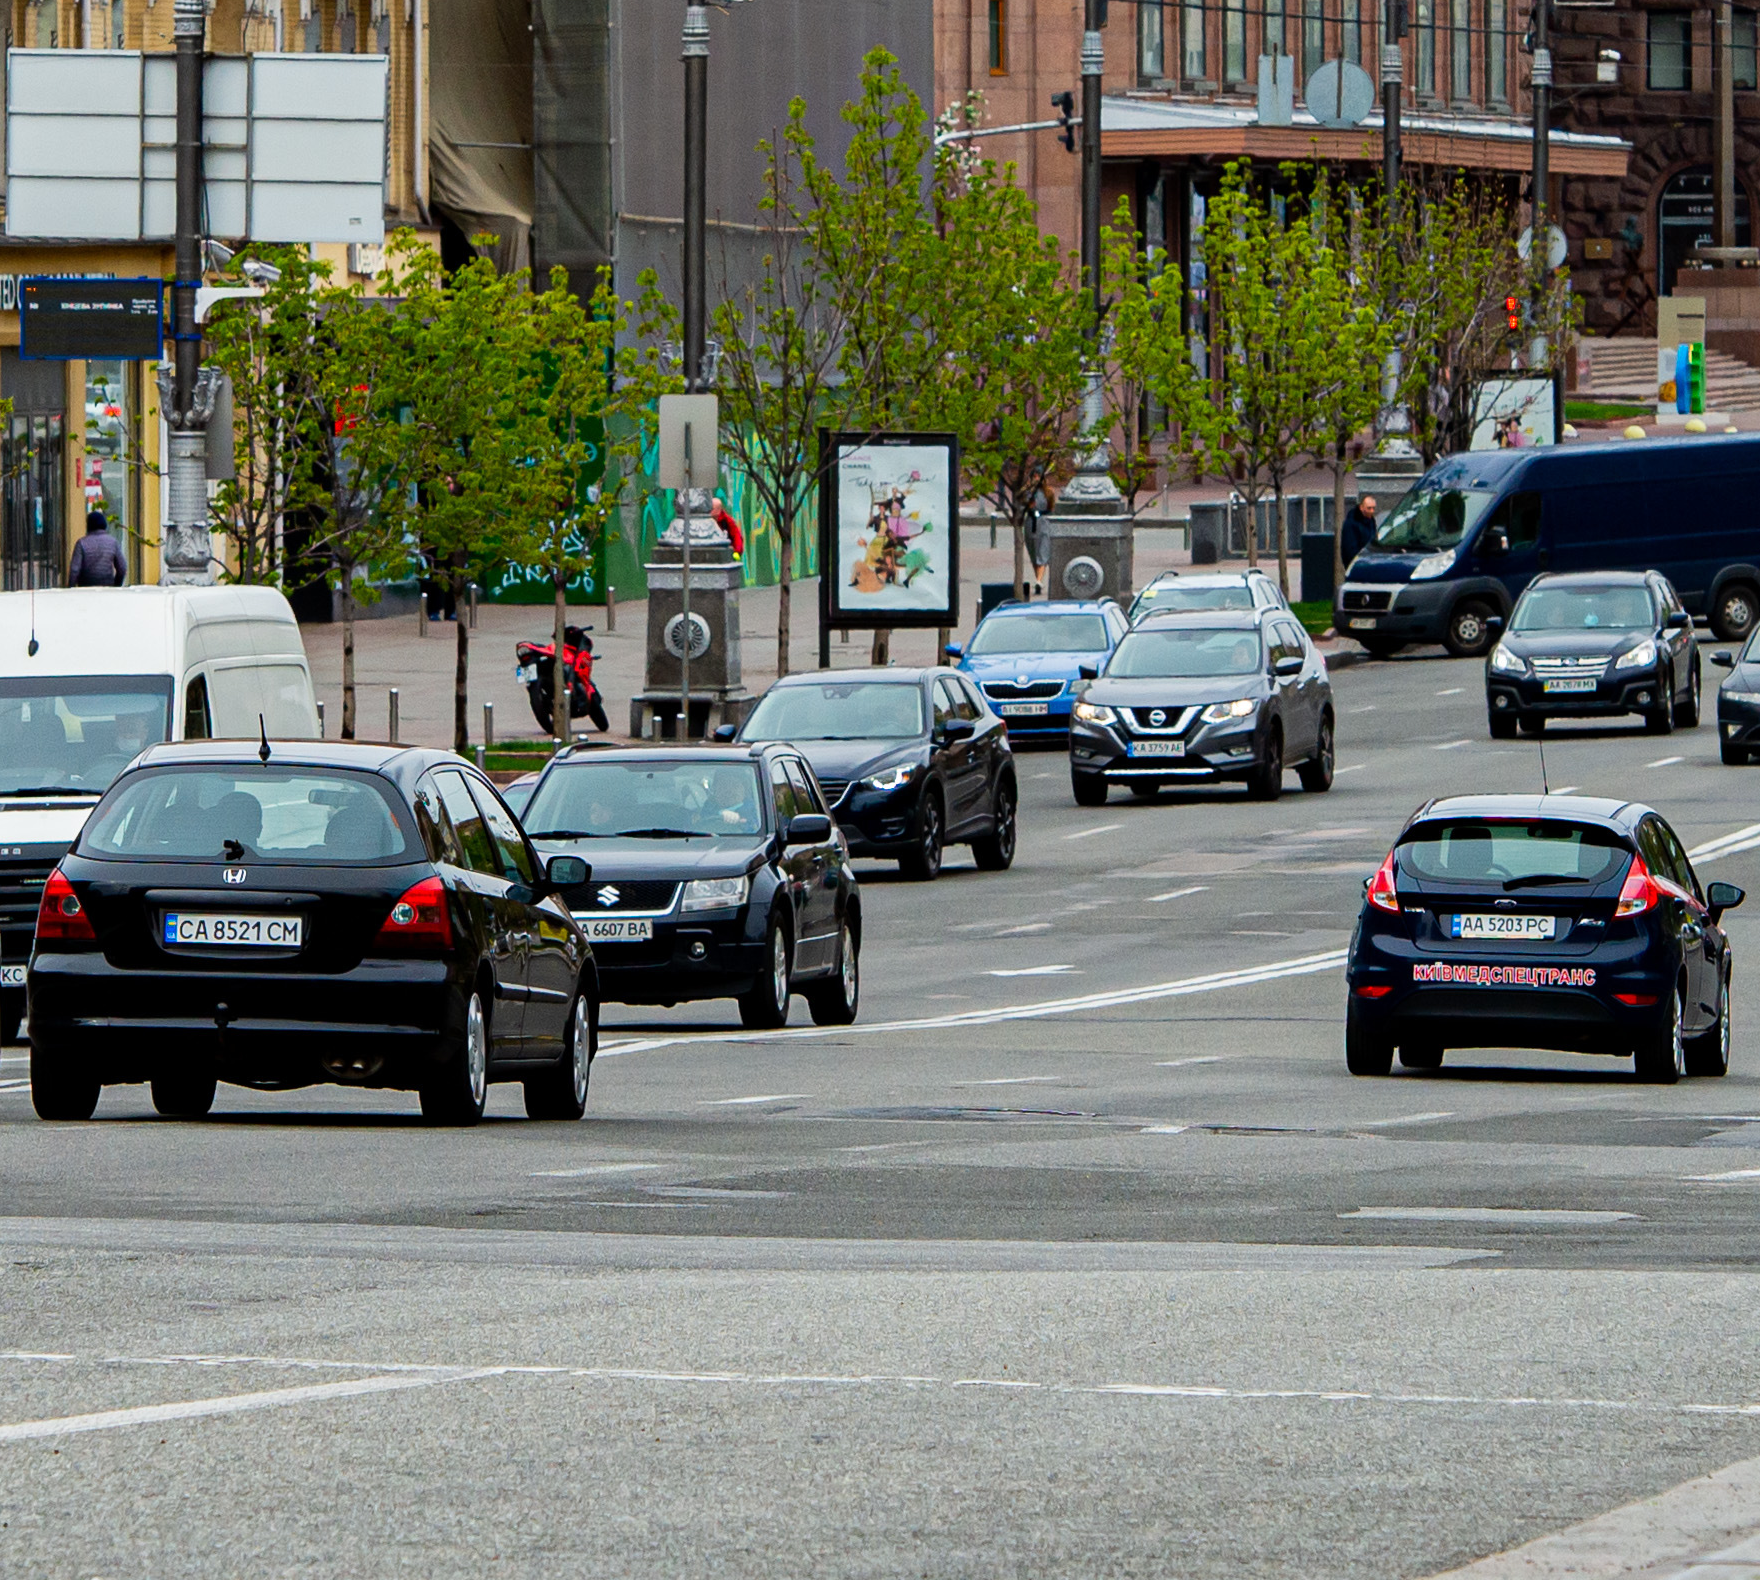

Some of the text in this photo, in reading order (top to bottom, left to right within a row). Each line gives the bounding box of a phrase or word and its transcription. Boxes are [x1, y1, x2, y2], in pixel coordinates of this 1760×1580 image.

[179, 920, 298, 942] CA 8521 CM
[593, 923, 624, 936] 6607
[628, 922, 648, 936] BA
[1463, 917, 1549, 932] AA 5203 PC
[2, 969, 23, 982] KC
[1413, 962, 1596, 987] КИЇВМЕДСПЕЦТРАНС
